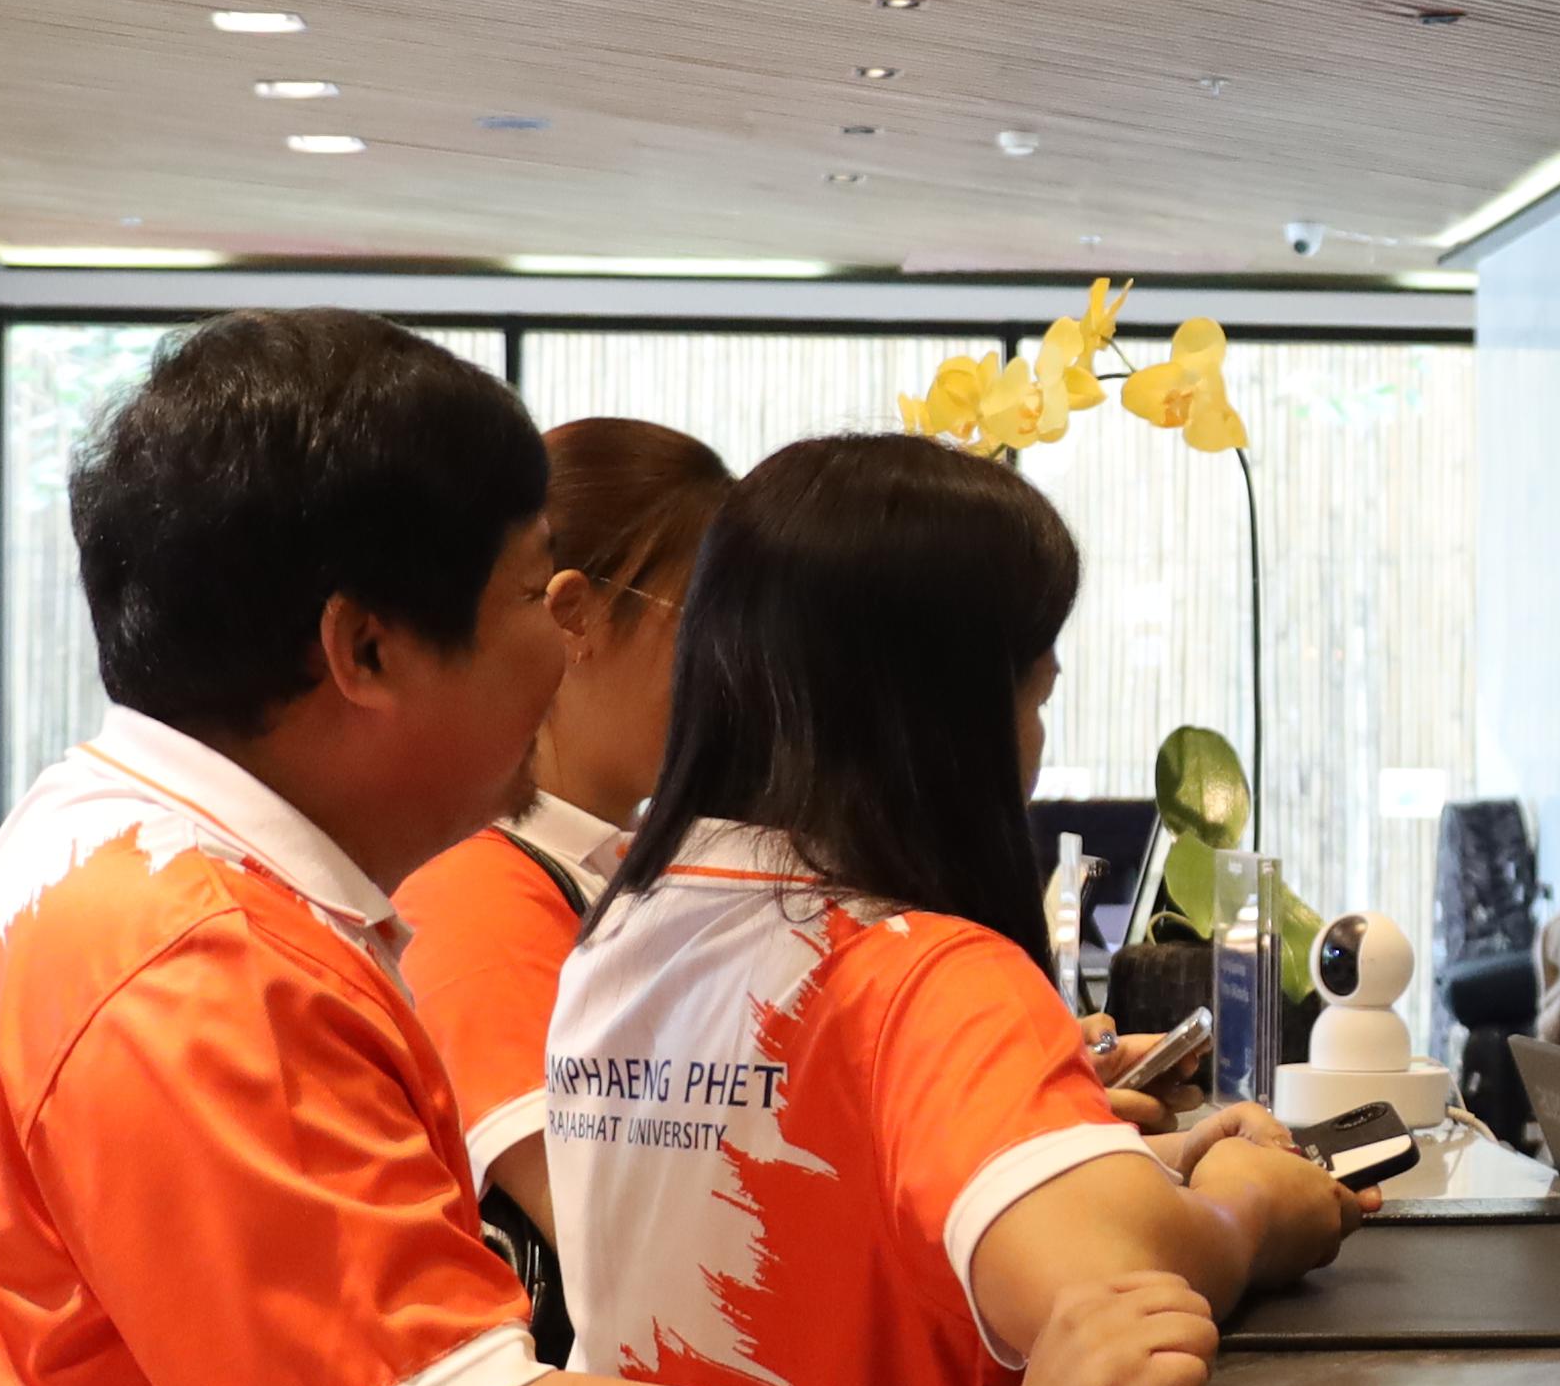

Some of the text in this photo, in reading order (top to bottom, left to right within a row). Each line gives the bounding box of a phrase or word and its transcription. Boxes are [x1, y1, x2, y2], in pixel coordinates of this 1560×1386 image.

[684, 1061, 784, 1109] PHET
[549, 1110, 728, 1152] RAJABHAT UNIVERSITY
